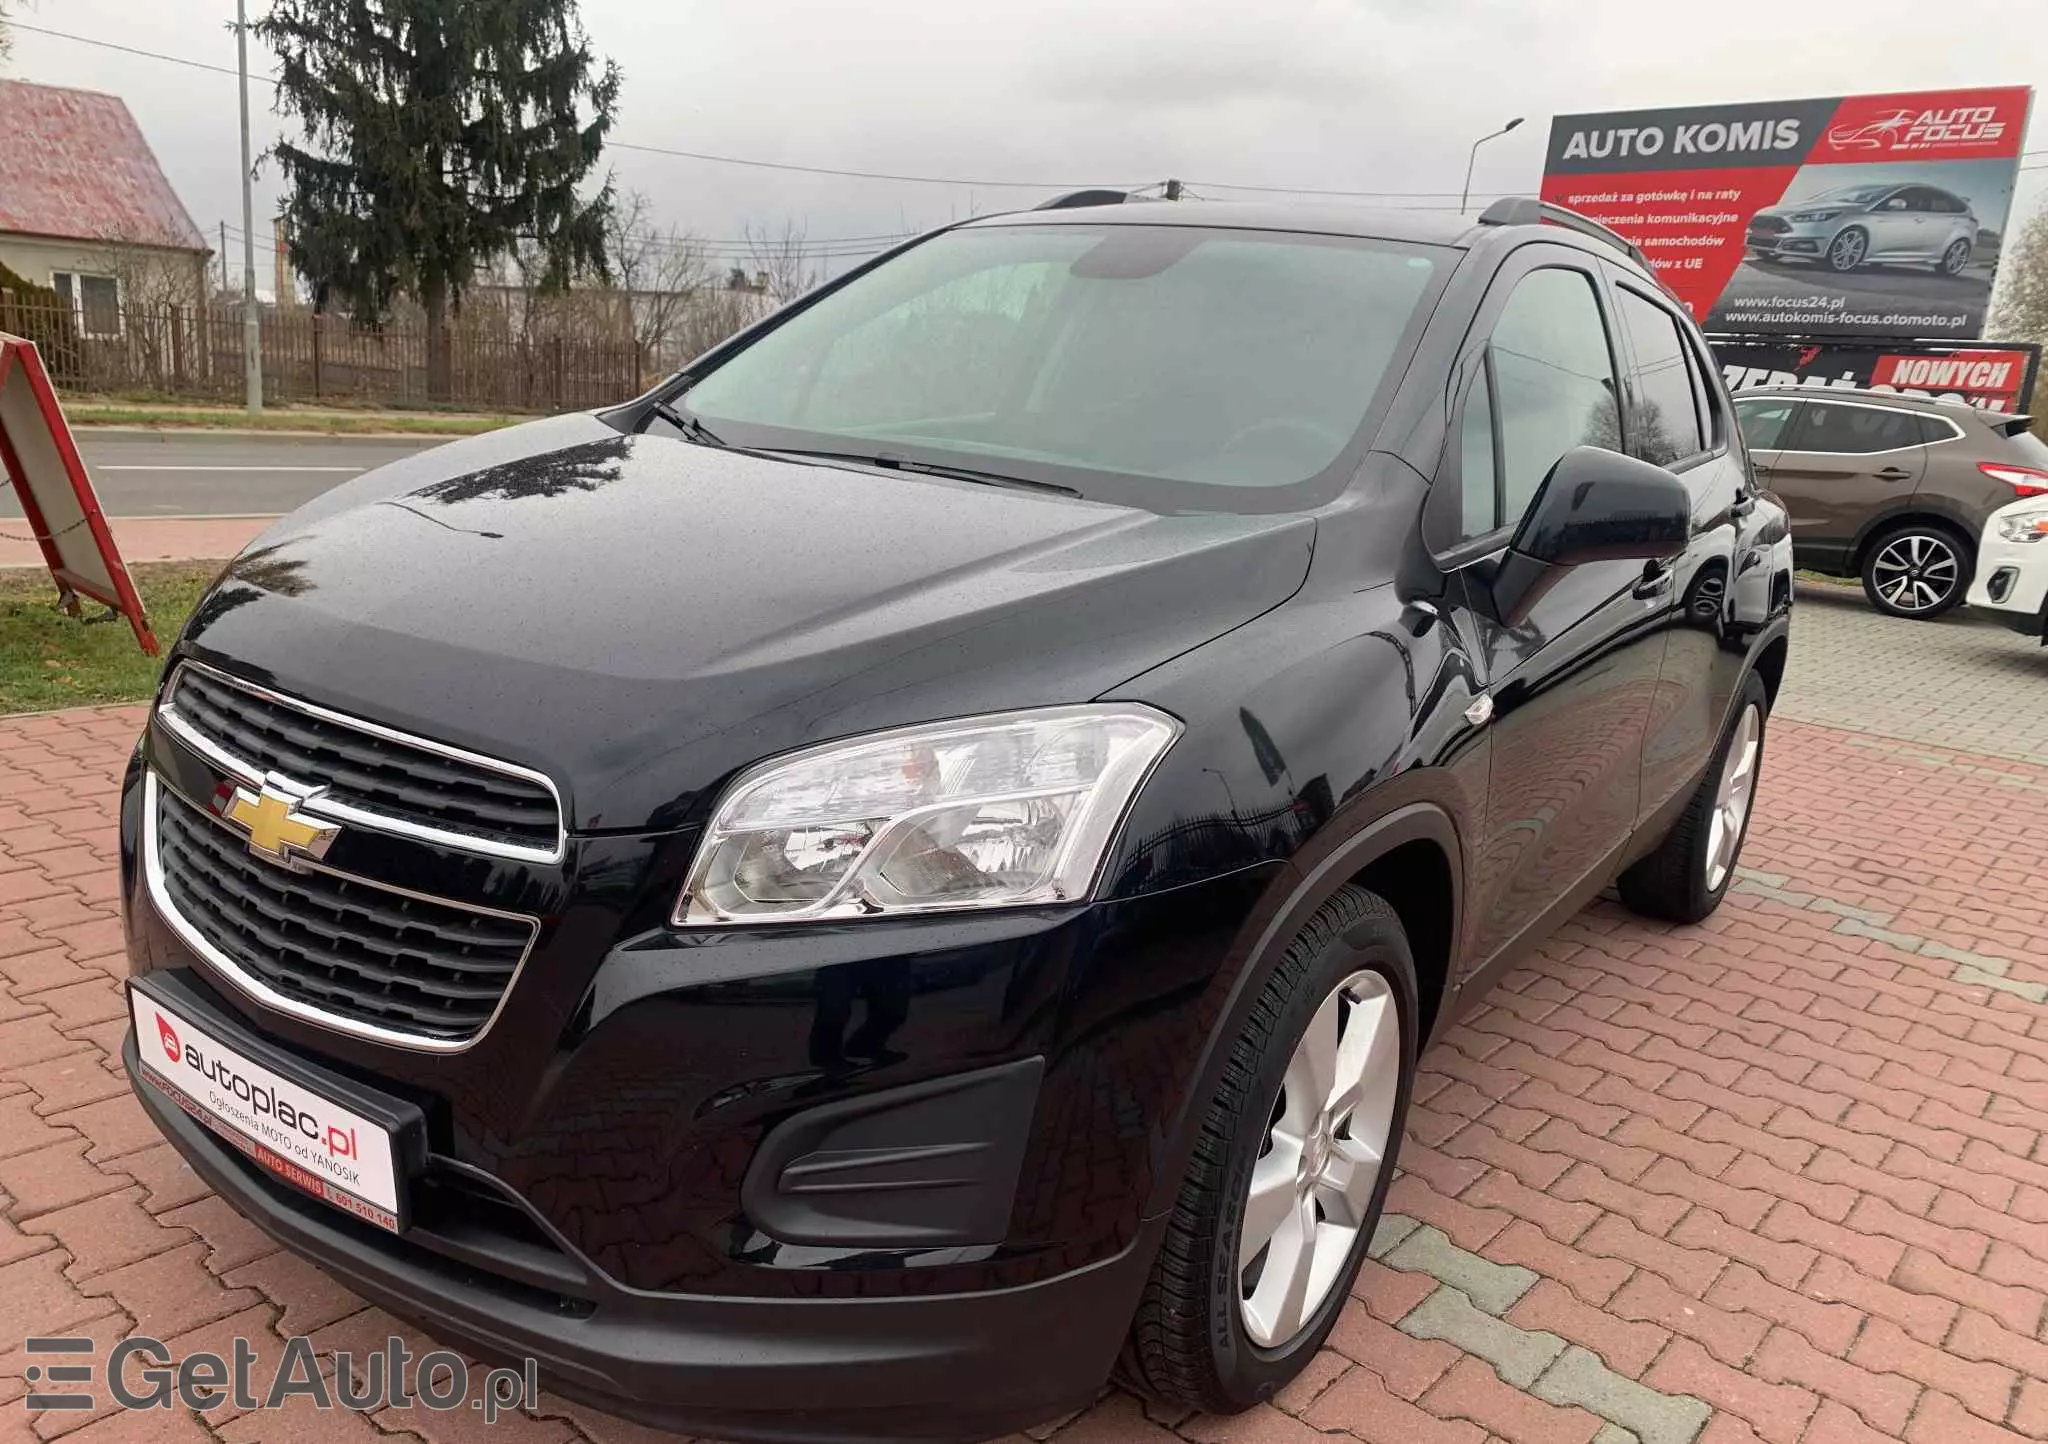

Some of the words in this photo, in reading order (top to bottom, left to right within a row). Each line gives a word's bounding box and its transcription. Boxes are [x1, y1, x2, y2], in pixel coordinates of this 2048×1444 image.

[1914, 106, 1997, 126] AUTO
[1562, 127, 1665, 160] AUTO
[1672, 118, 1801, 154] KOMIS
[1904, 122, 2006, 142] FOCUS
[1620, 193, 1634, 203] za
[1697, 191, 1713, 200] na
[1714, 189, 1742, 202] raty
[1647, 211, 1739, 226] komunikacyjne
[1644, 235, 1726, 247] samochodów
[1684, 258, 1704, 270] UE
[1734, 295, 1847, 310] www.focus24.pl
[1725, 310, 1968, 329] www.autokomis-focus.otomoto.pl
[1890, 358, 2012, 388] NOWYCH
[185, 1043, 358, 1161] autoplac.pl
[208, 1090, 260, 1132] Ogłoszenia
[261, 1123, 293, 1150] MOTO
[294, 1144, 309, 1160] od
[310, 1151, 361, 1187] YANOSIK
[256, 1148, 282, 1171] AUTO
[284, 1165, 322, 1194] SERWIS
[355, 1202, 374, 1219] 510
[376, 1214, 396, 1231] 140
